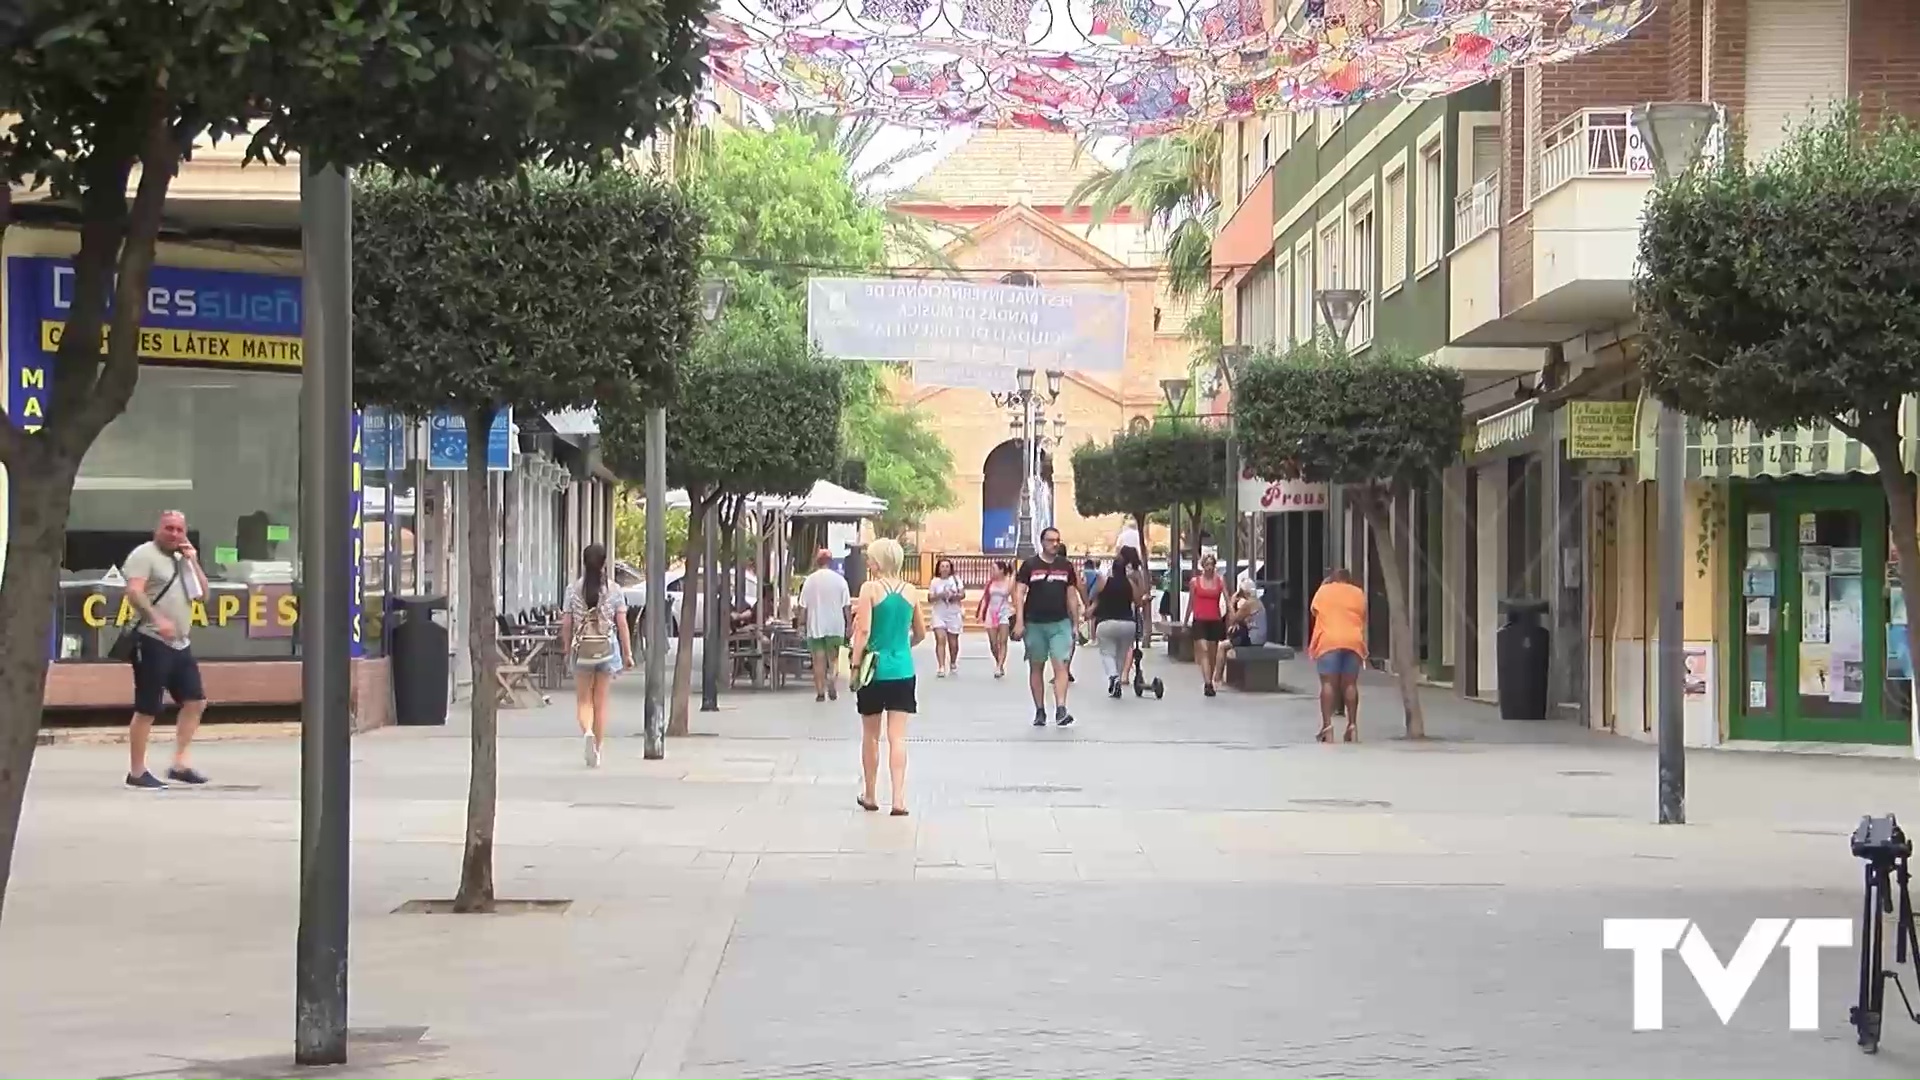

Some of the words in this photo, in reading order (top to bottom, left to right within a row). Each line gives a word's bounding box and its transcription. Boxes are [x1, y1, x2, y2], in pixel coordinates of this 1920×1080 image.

[242, 341, 300, 359] MATTR
[1702, 446, 1829, 467] HERBOLARIO
[82, 585, 299, 628] CAAPÉS
